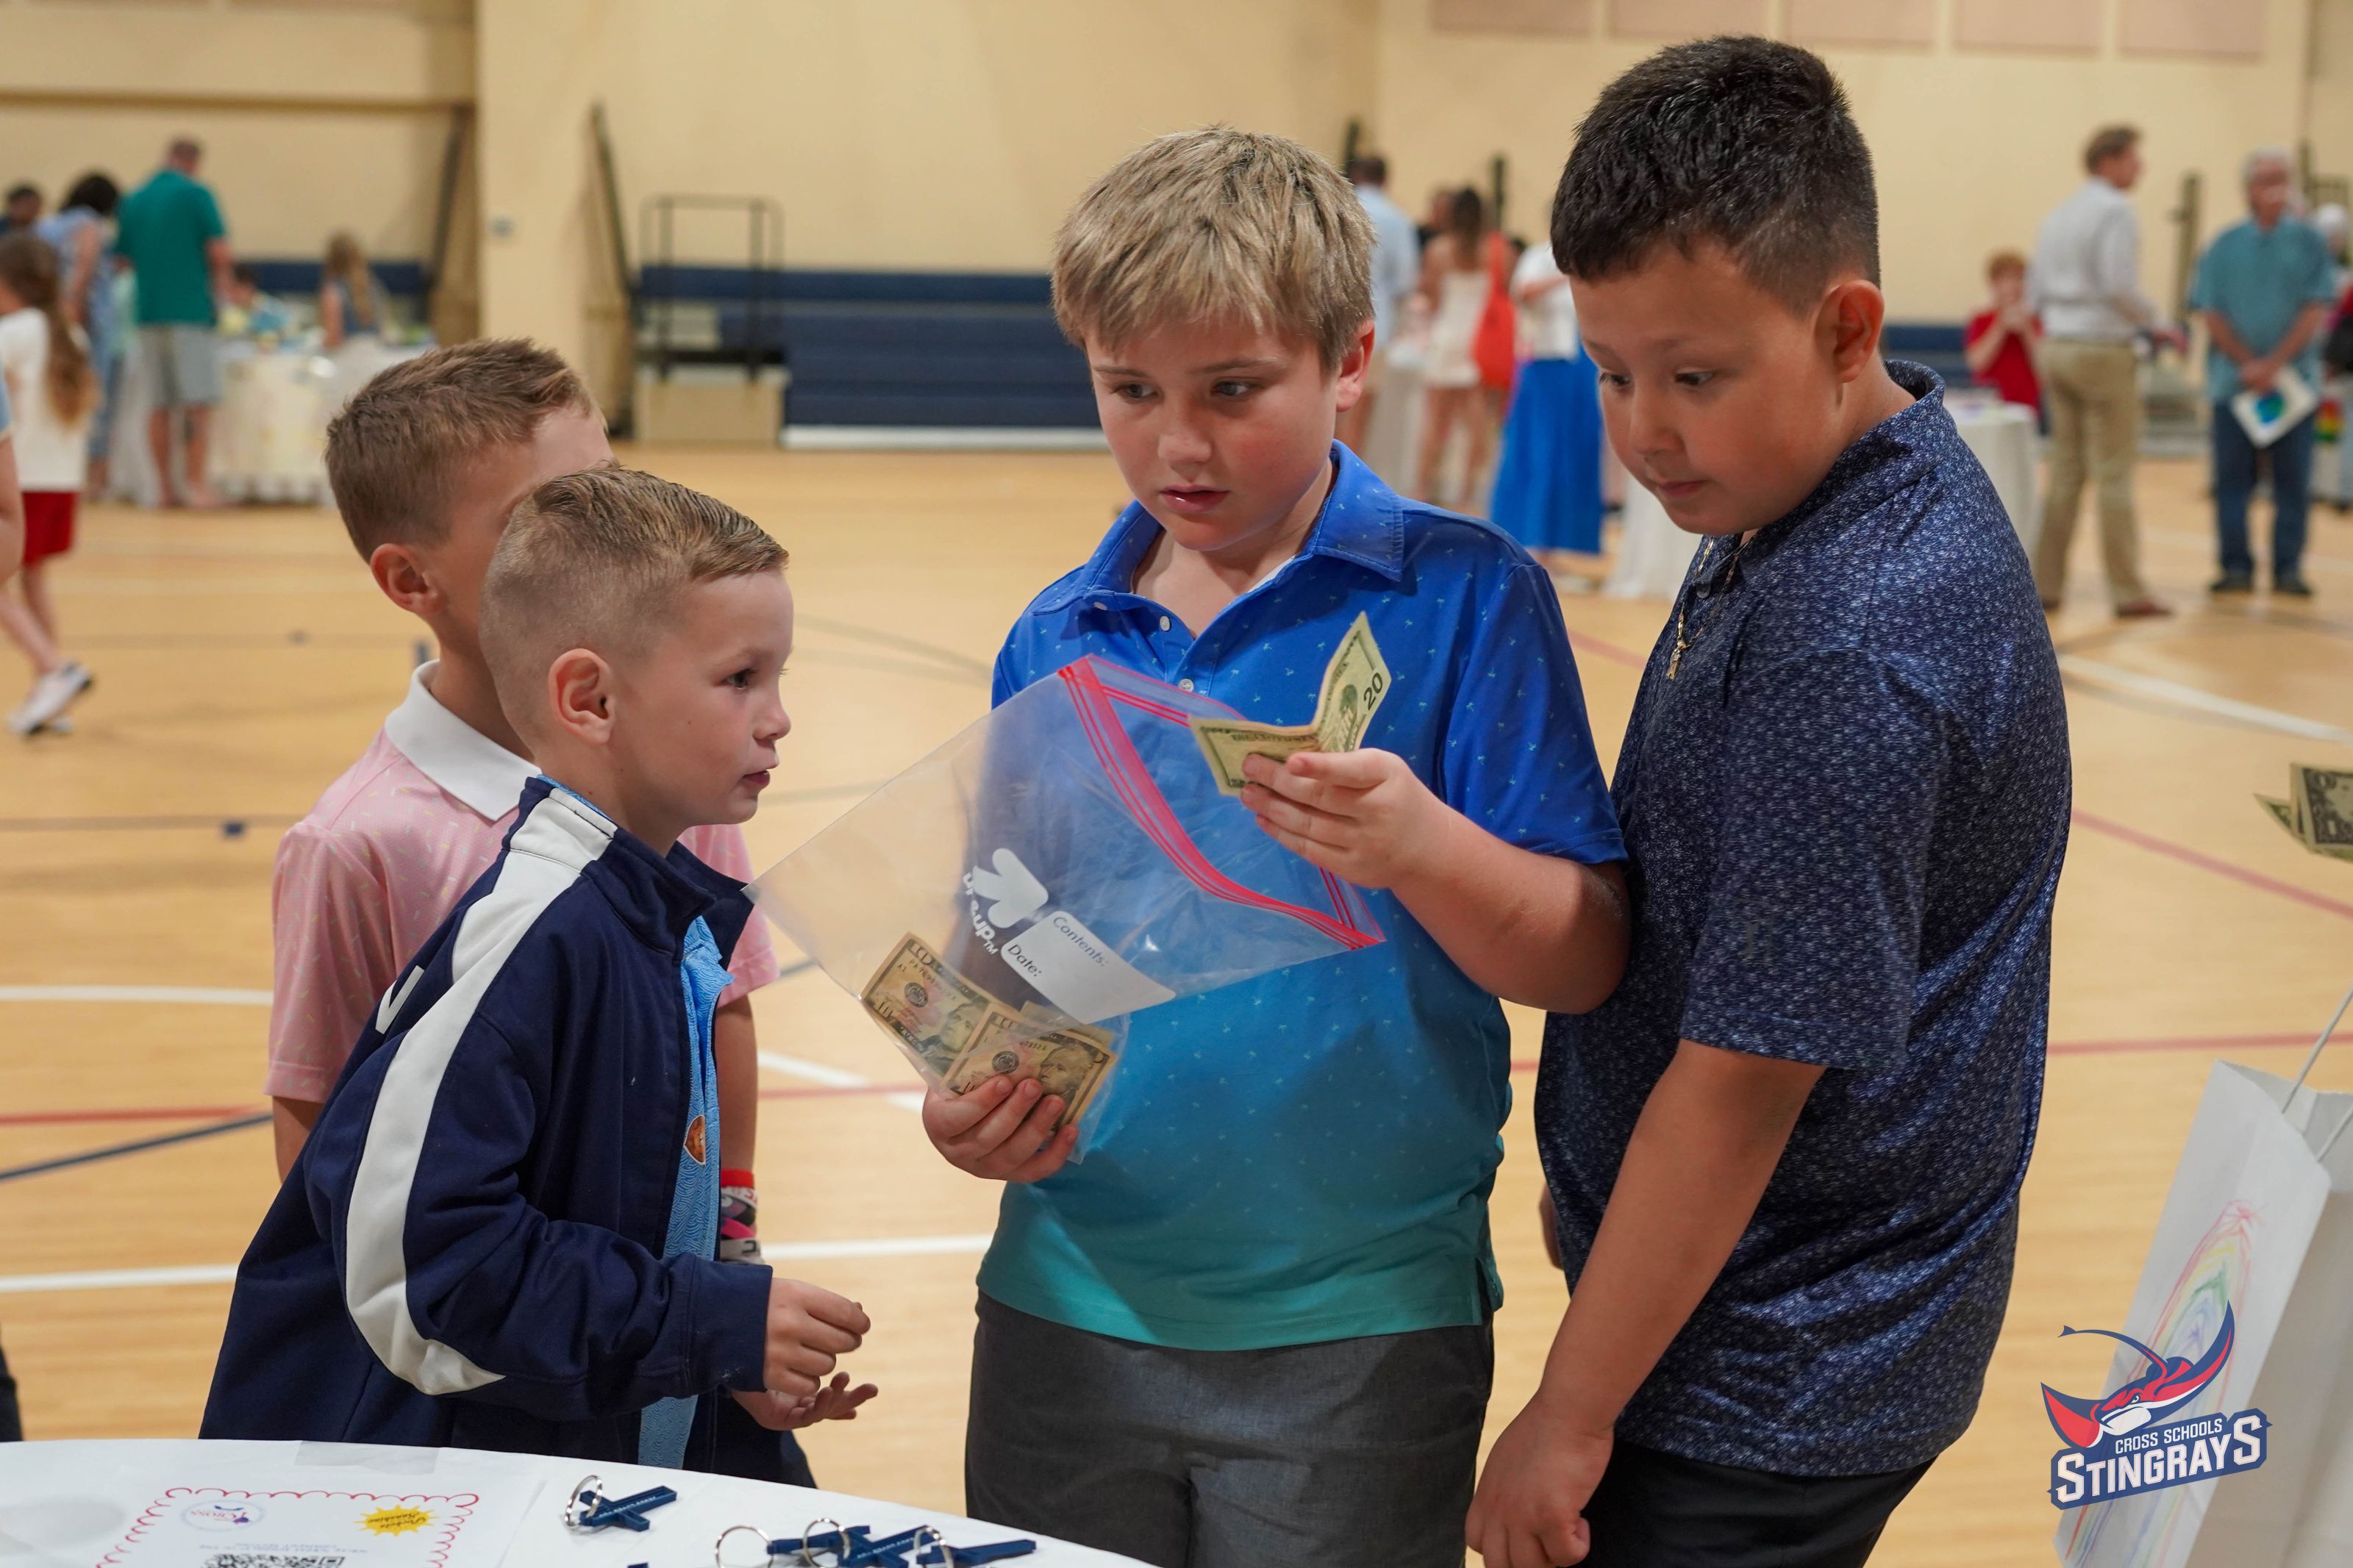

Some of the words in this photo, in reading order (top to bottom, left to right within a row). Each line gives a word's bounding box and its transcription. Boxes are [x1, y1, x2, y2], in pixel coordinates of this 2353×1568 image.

[1363, 672, 1383, 710] 20
[1007, 944, 1042, 977] Date:
[1053, 917, 1109, 967] Contents:
